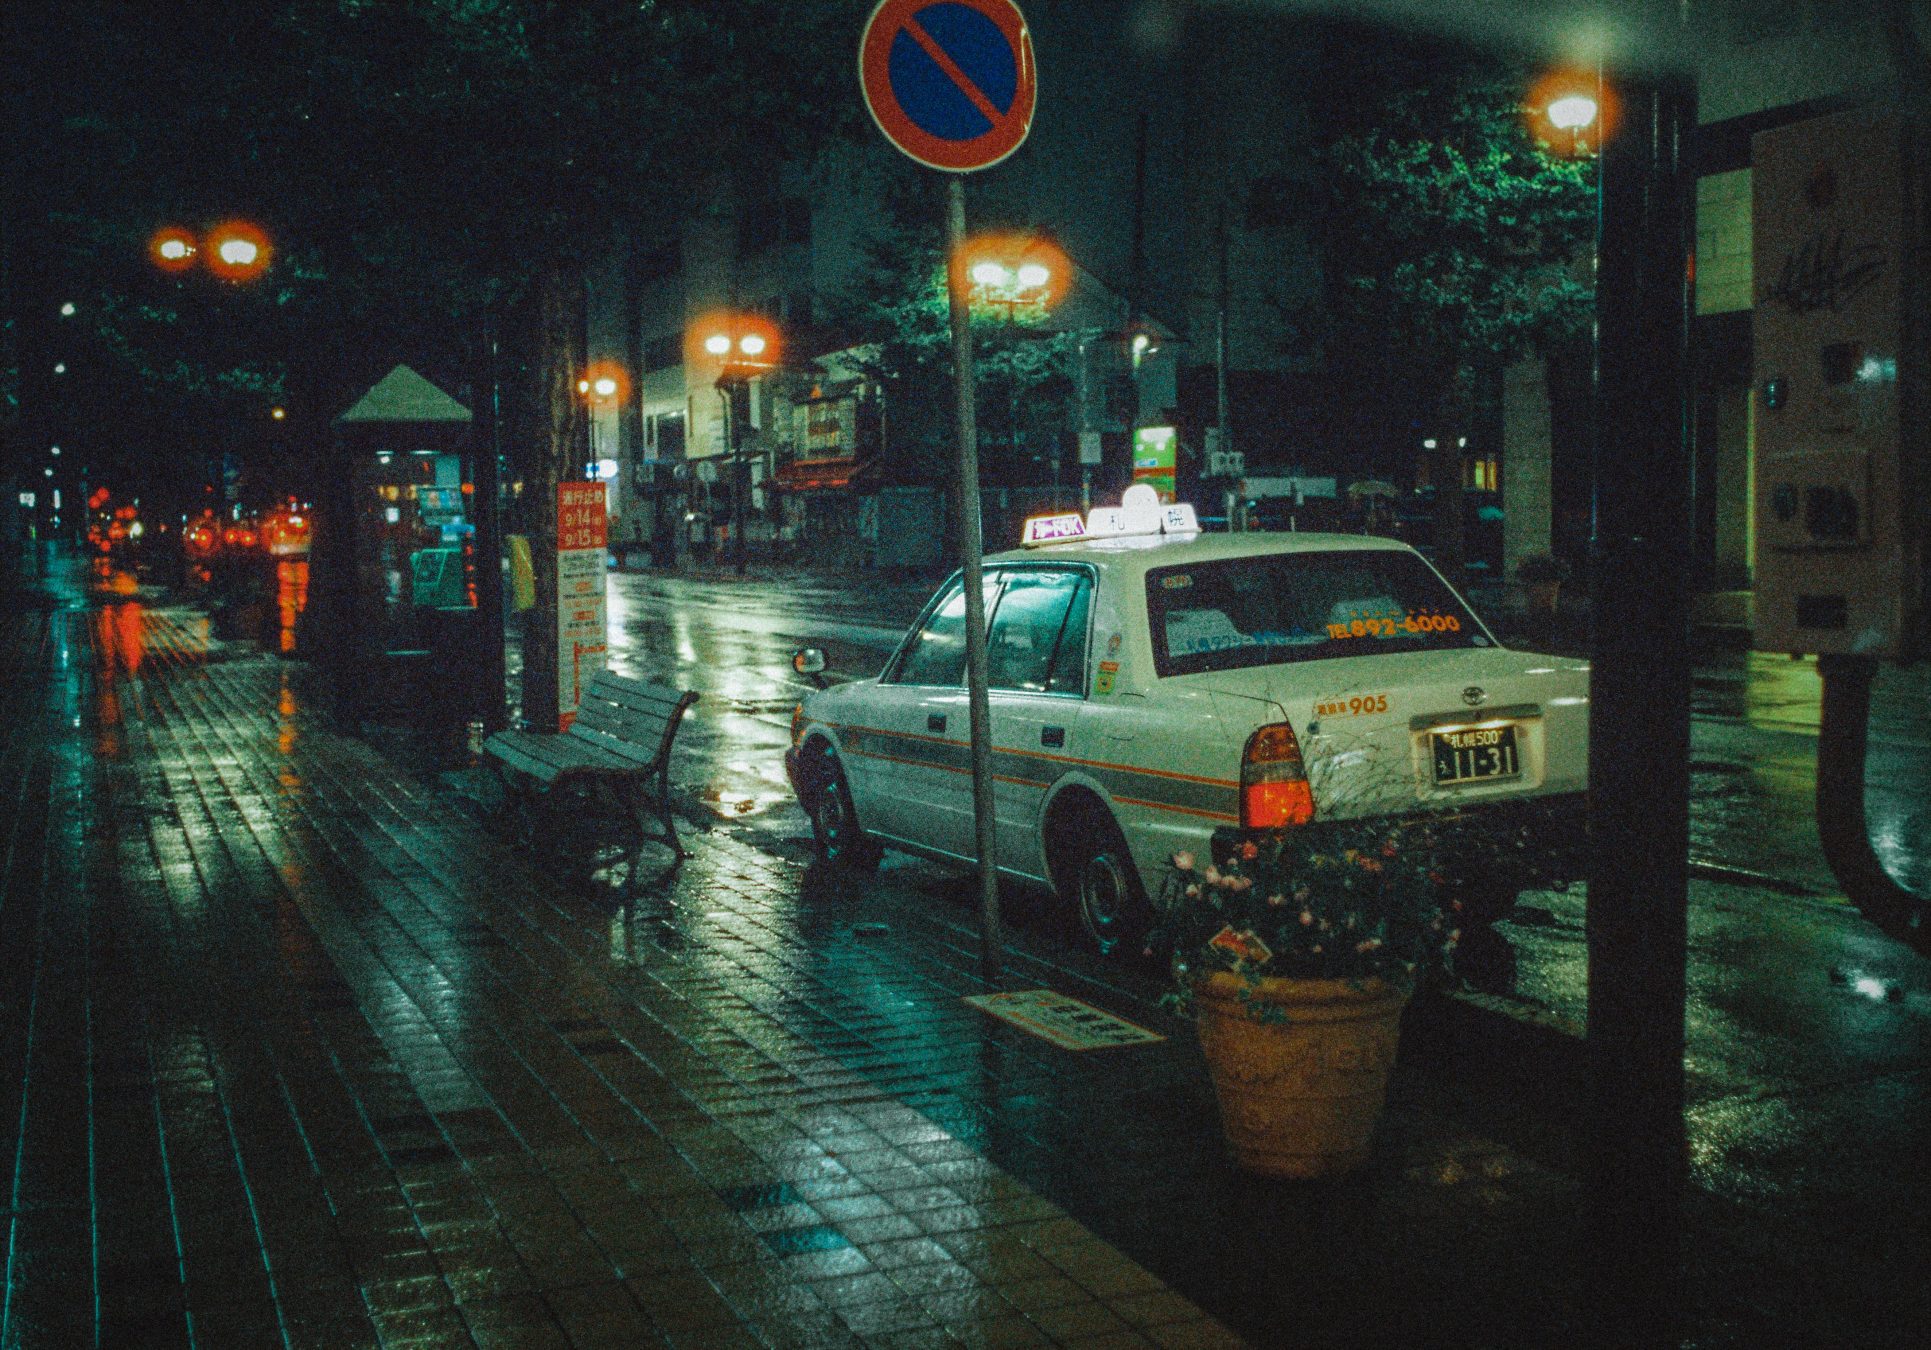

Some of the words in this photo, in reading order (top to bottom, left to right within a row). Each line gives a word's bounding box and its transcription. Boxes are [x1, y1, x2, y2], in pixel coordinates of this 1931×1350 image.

[1326, 623, 1352, 640] TEL
[1350, 614, 1462, 639] 892-6000
[1349, 695, 1388, 716] 905
[1454, 746, 1513, 780] 11-31
